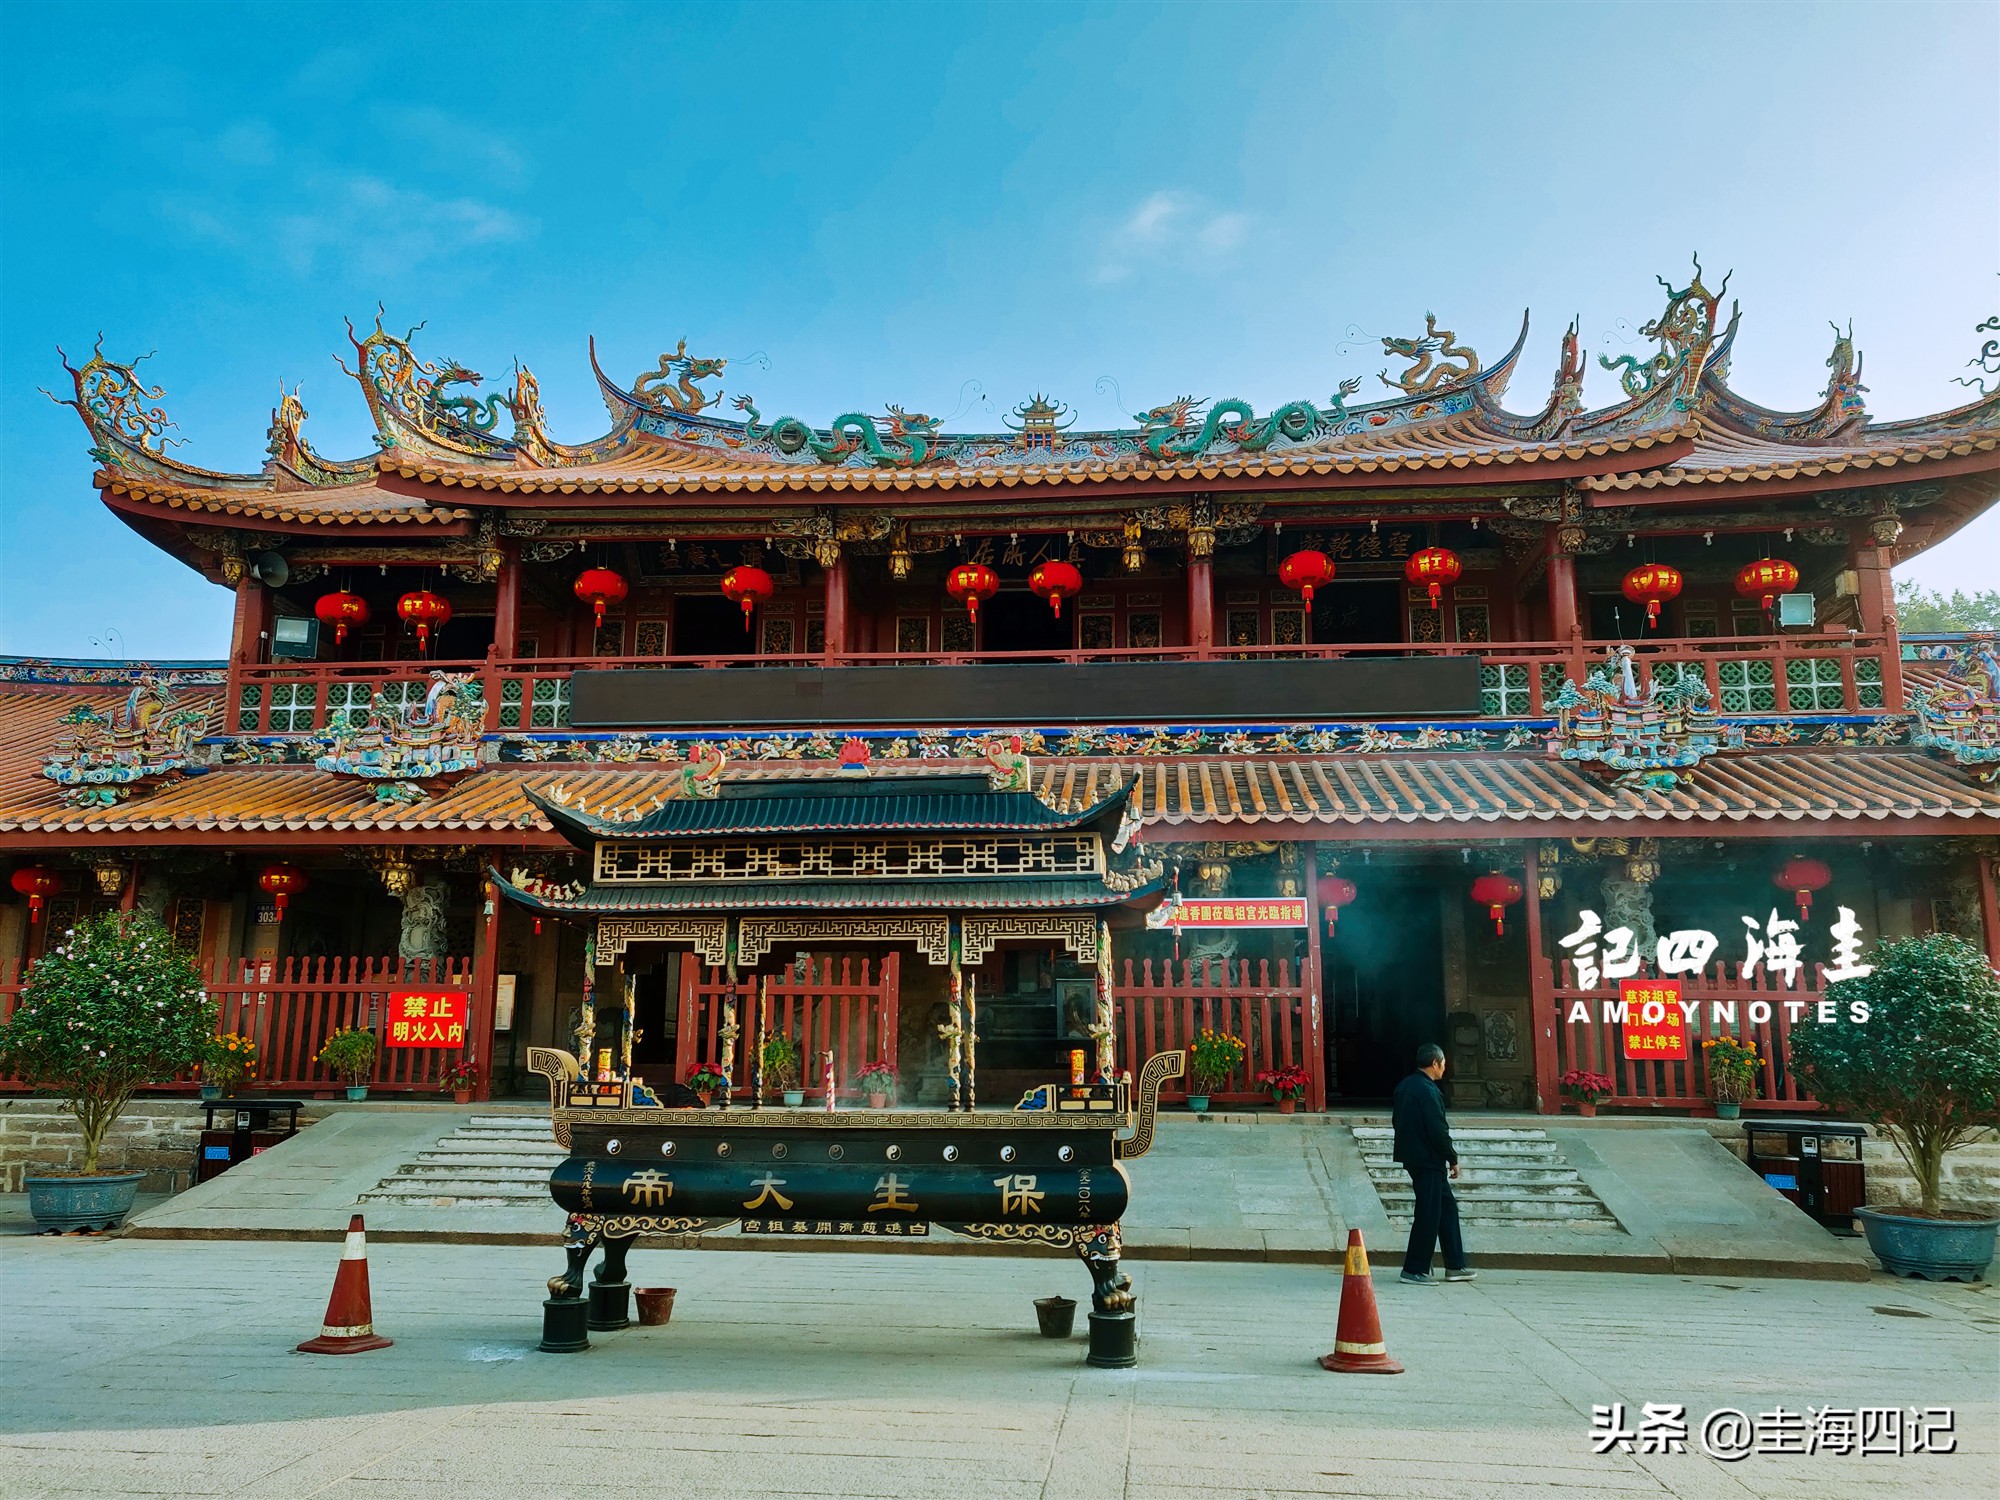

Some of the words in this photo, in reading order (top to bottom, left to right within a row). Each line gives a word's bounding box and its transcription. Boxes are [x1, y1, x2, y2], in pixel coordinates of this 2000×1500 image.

[403, 996, 453, 1018] 禁止
[1626, 1012, 1680, 1027] 门口场
[392, 1021, 463, 1044] 明火入内
[1628, 1034, 1682, 1050] 禁止停车
